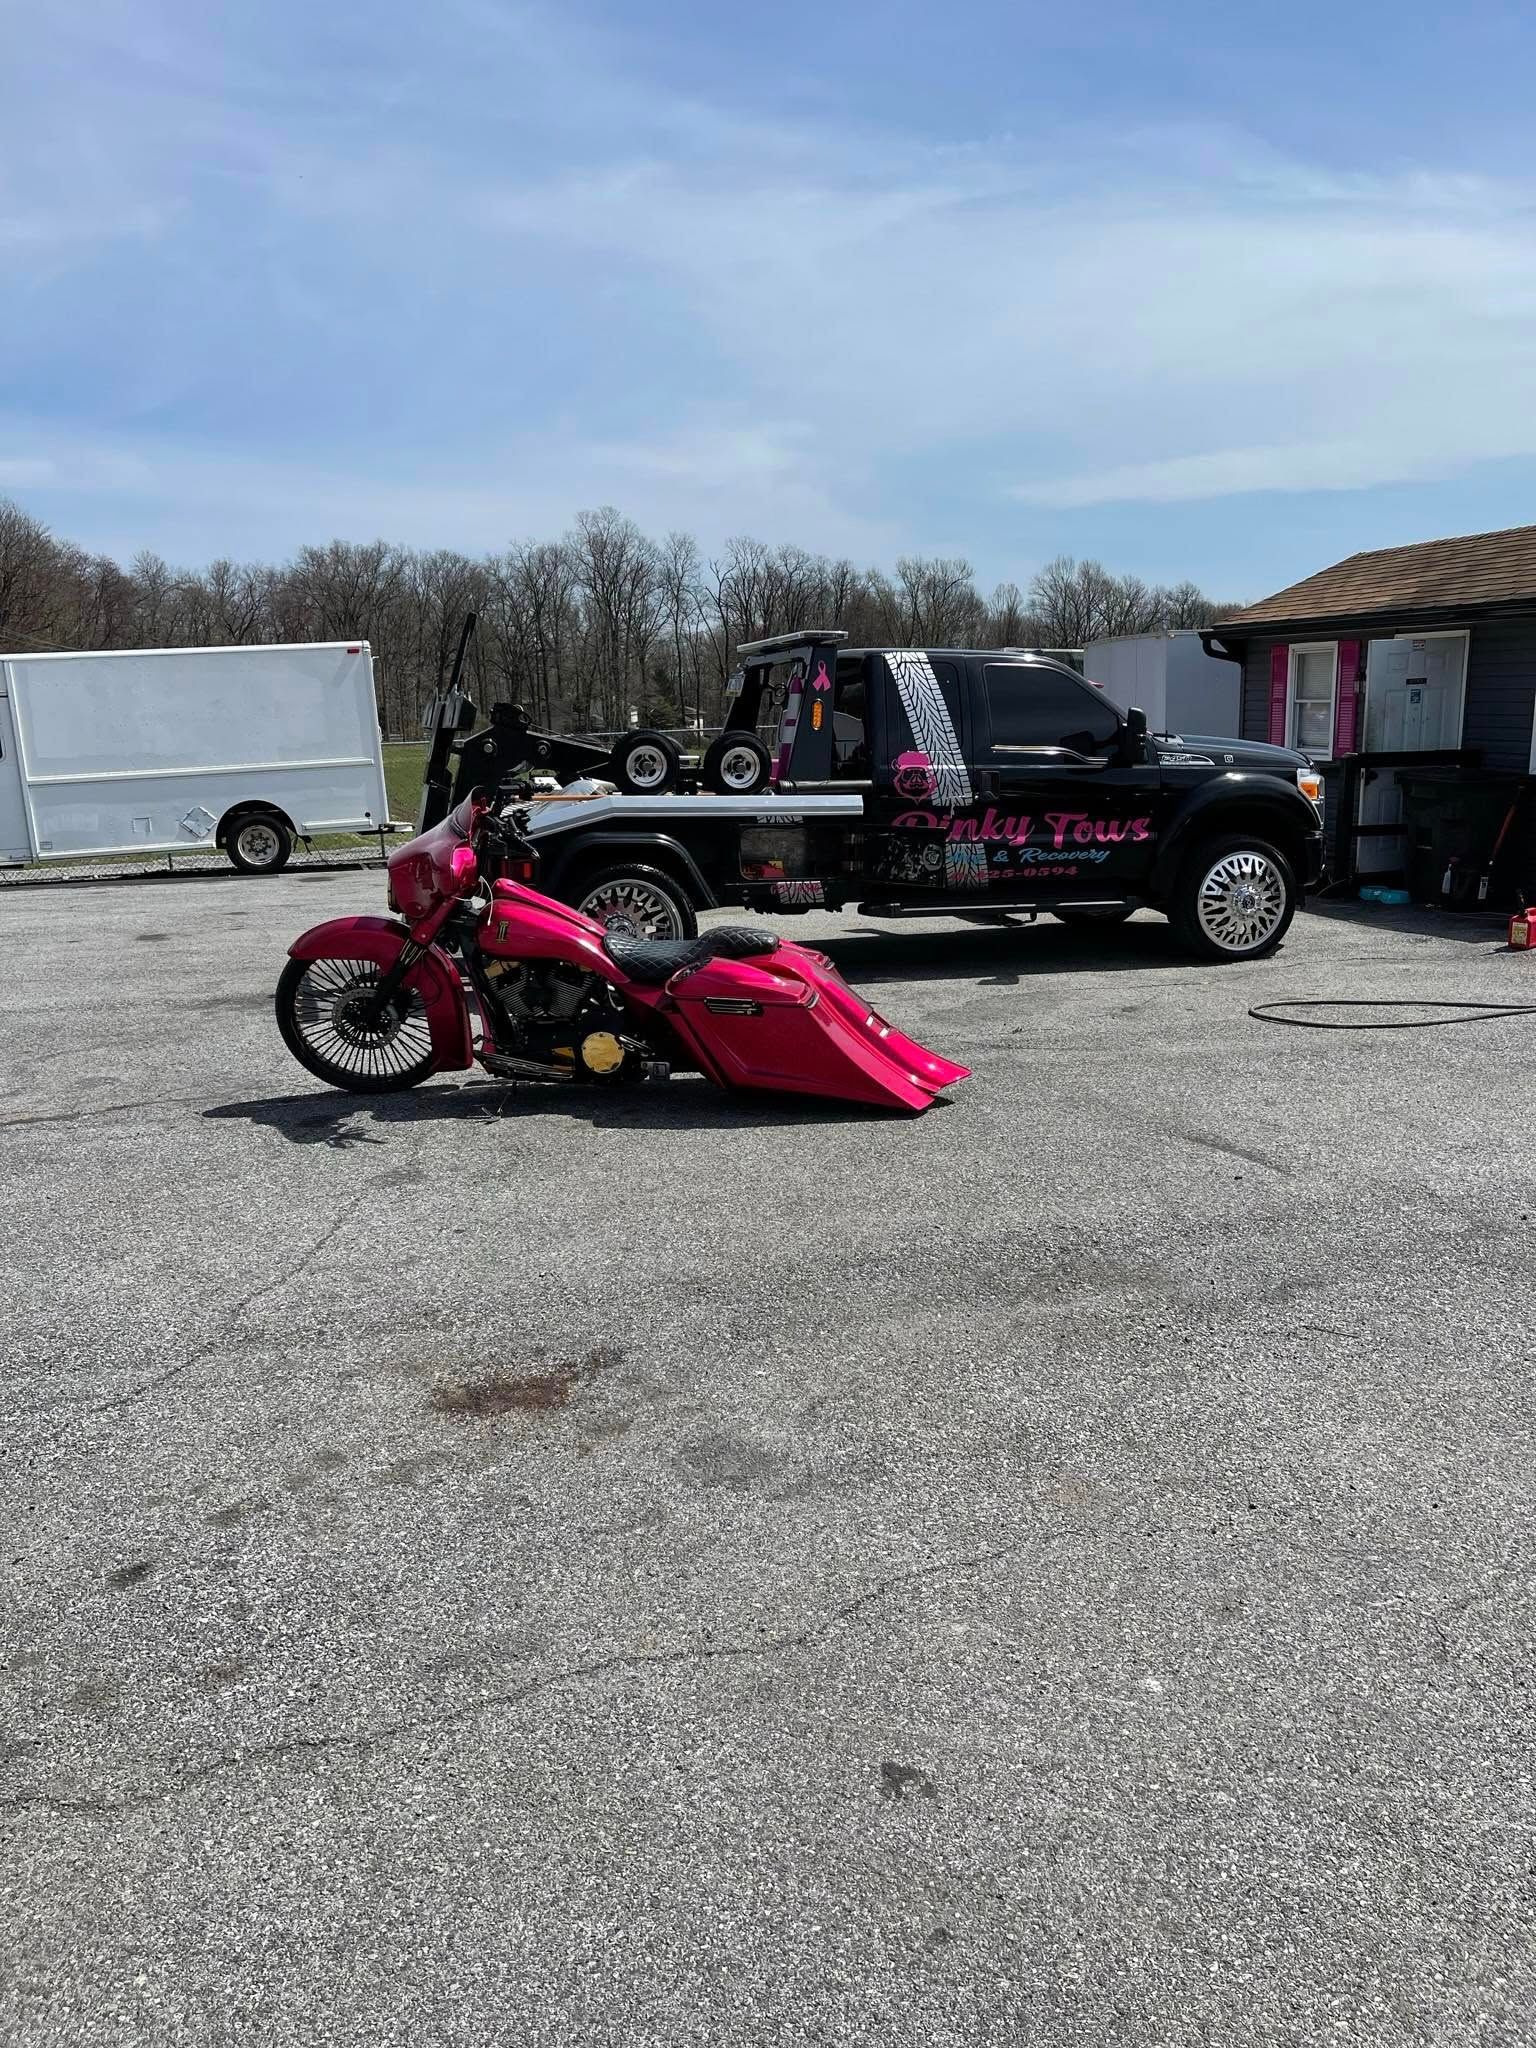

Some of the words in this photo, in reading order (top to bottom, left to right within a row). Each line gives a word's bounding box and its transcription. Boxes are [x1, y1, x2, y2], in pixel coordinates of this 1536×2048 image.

[1044, 813, 1151, 849] Tows
[993, 850, 1009, 862] &
[1019, 847, 1111, 864] Recovery
